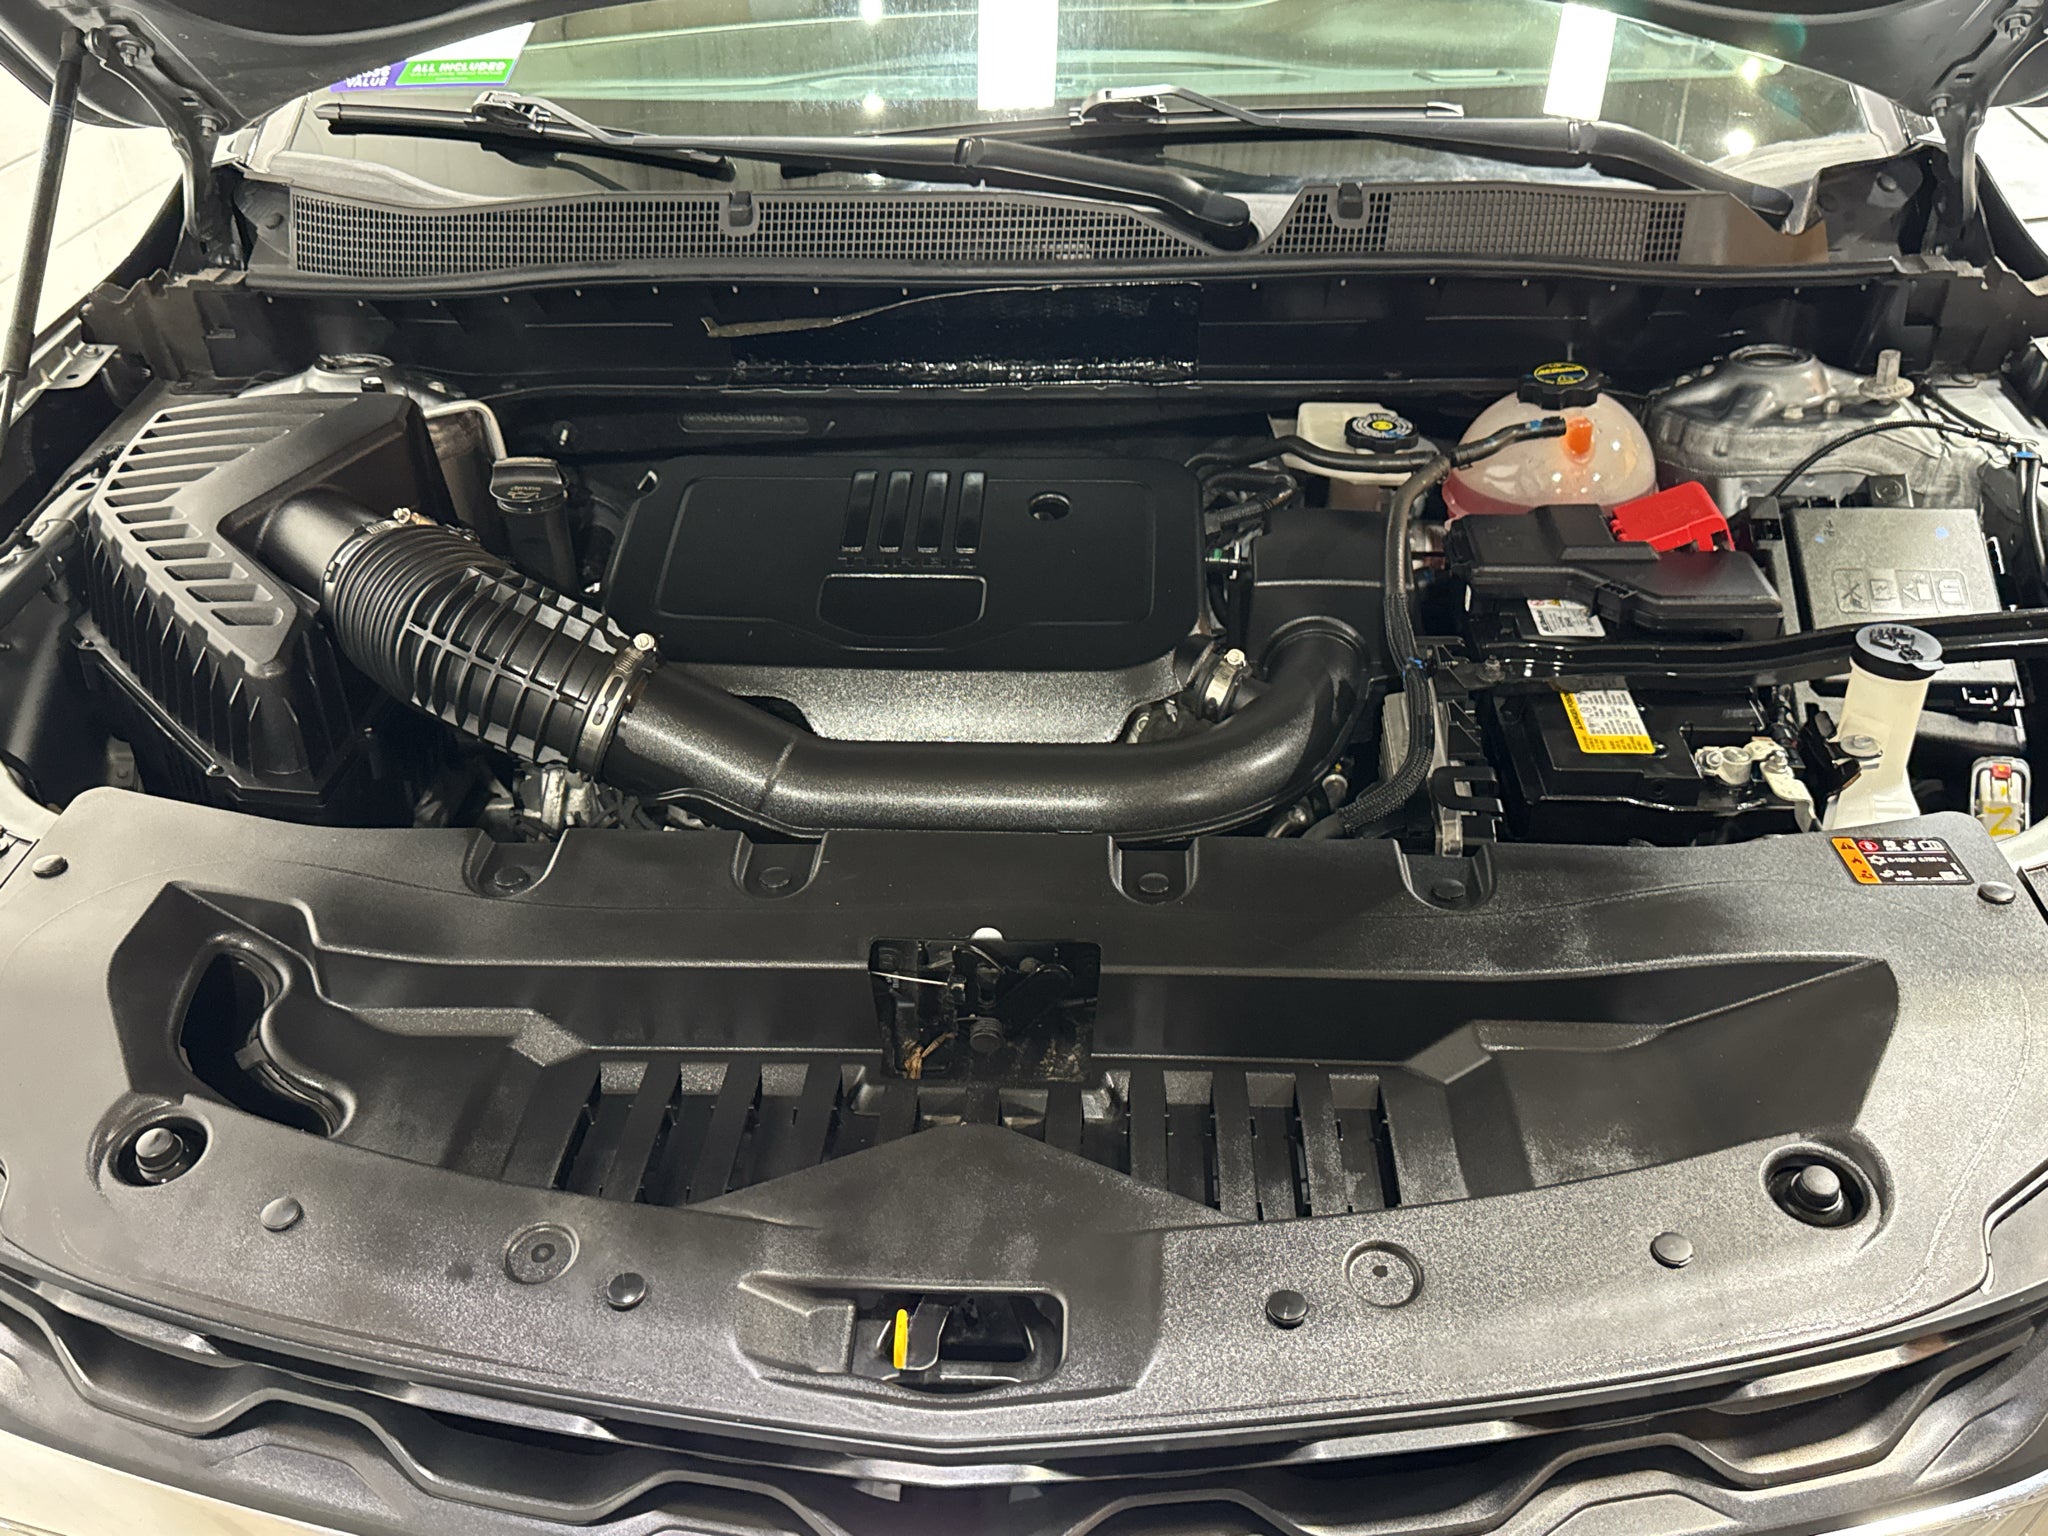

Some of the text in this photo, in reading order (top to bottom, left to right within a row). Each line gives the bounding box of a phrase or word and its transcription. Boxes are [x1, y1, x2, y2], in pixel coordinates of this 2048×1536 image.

[412, 61, 507, 73] ALL INCLUDED
[346, 75, 389, 88] VALUE
